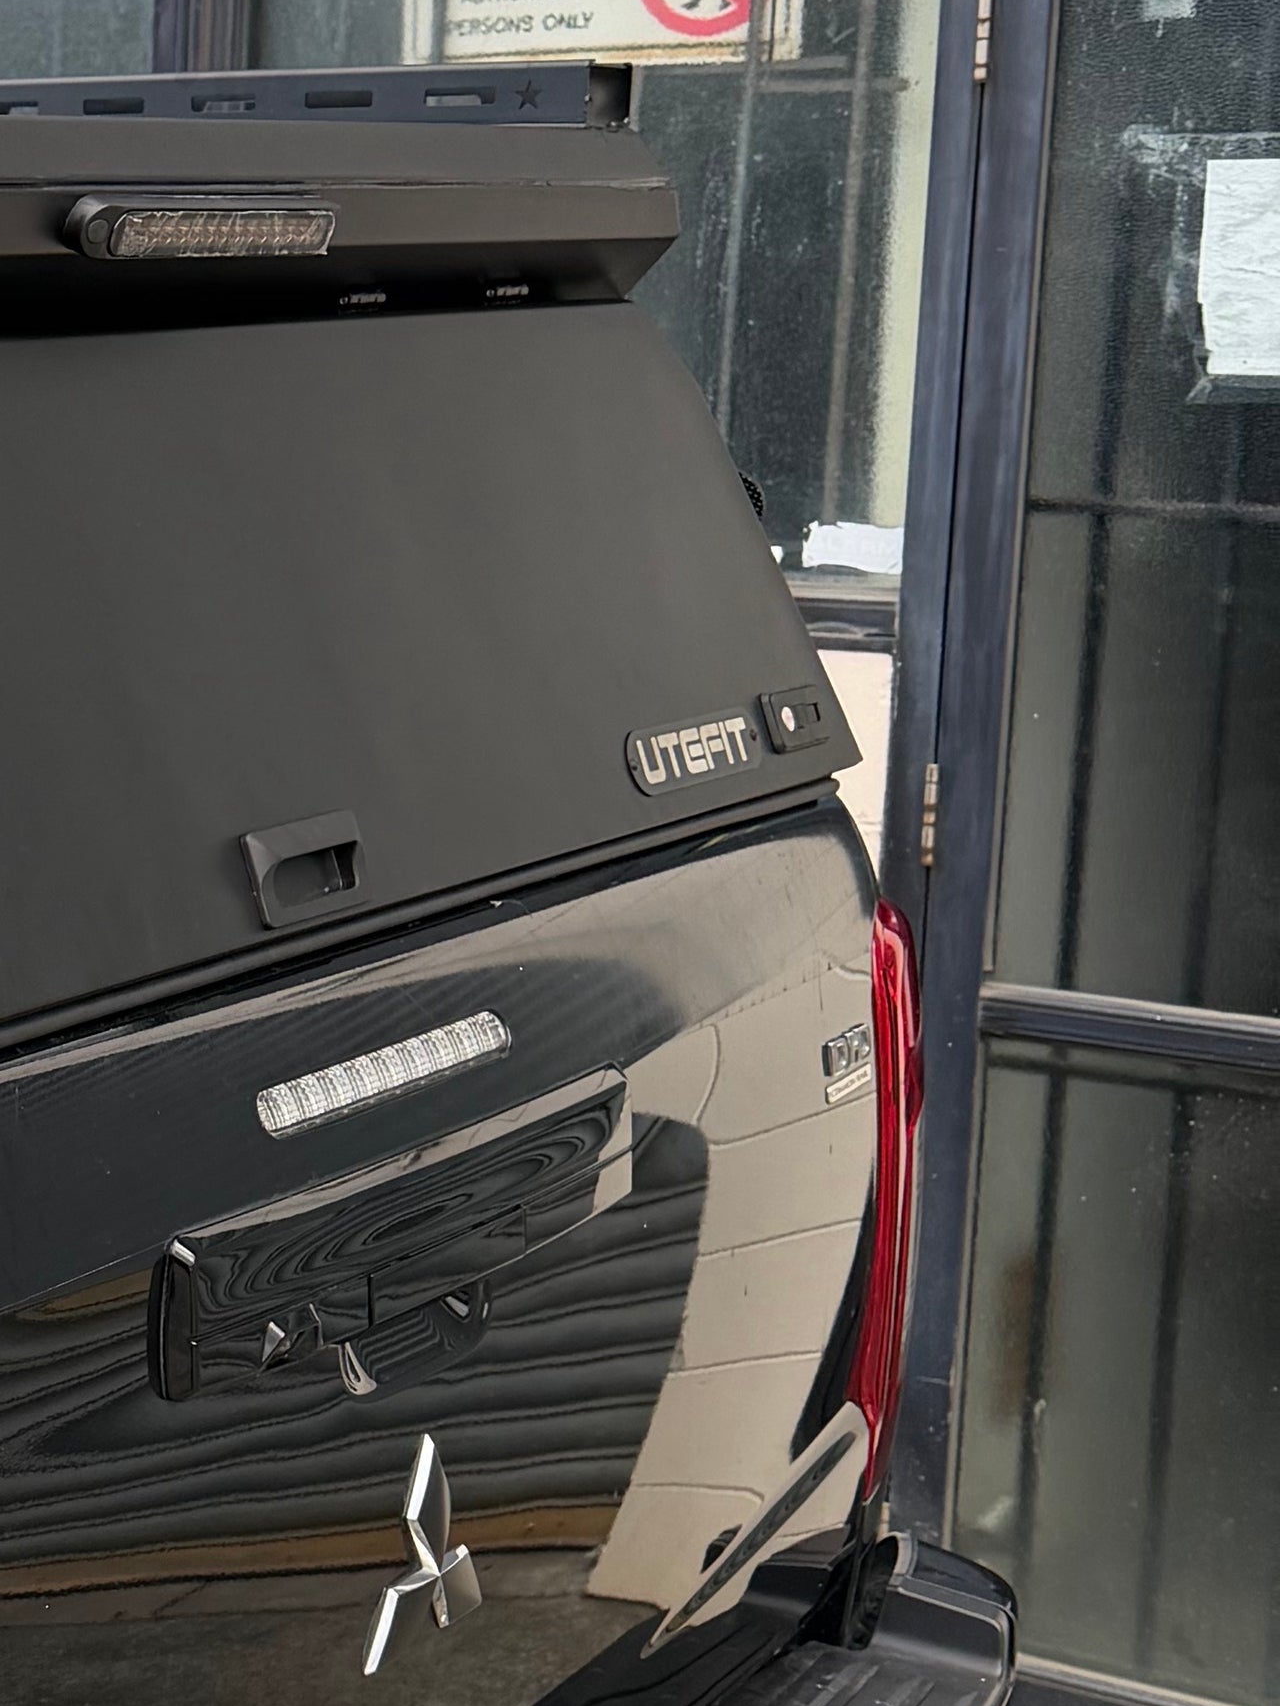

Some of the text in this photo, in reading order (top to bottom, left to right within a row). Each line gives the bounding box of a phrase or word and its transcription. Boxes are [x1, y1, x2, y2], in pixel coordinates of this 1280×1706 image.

[445, 11, 594, 37] PERSONS ONLY
[635, 716, 747, 785] UTEFIT
